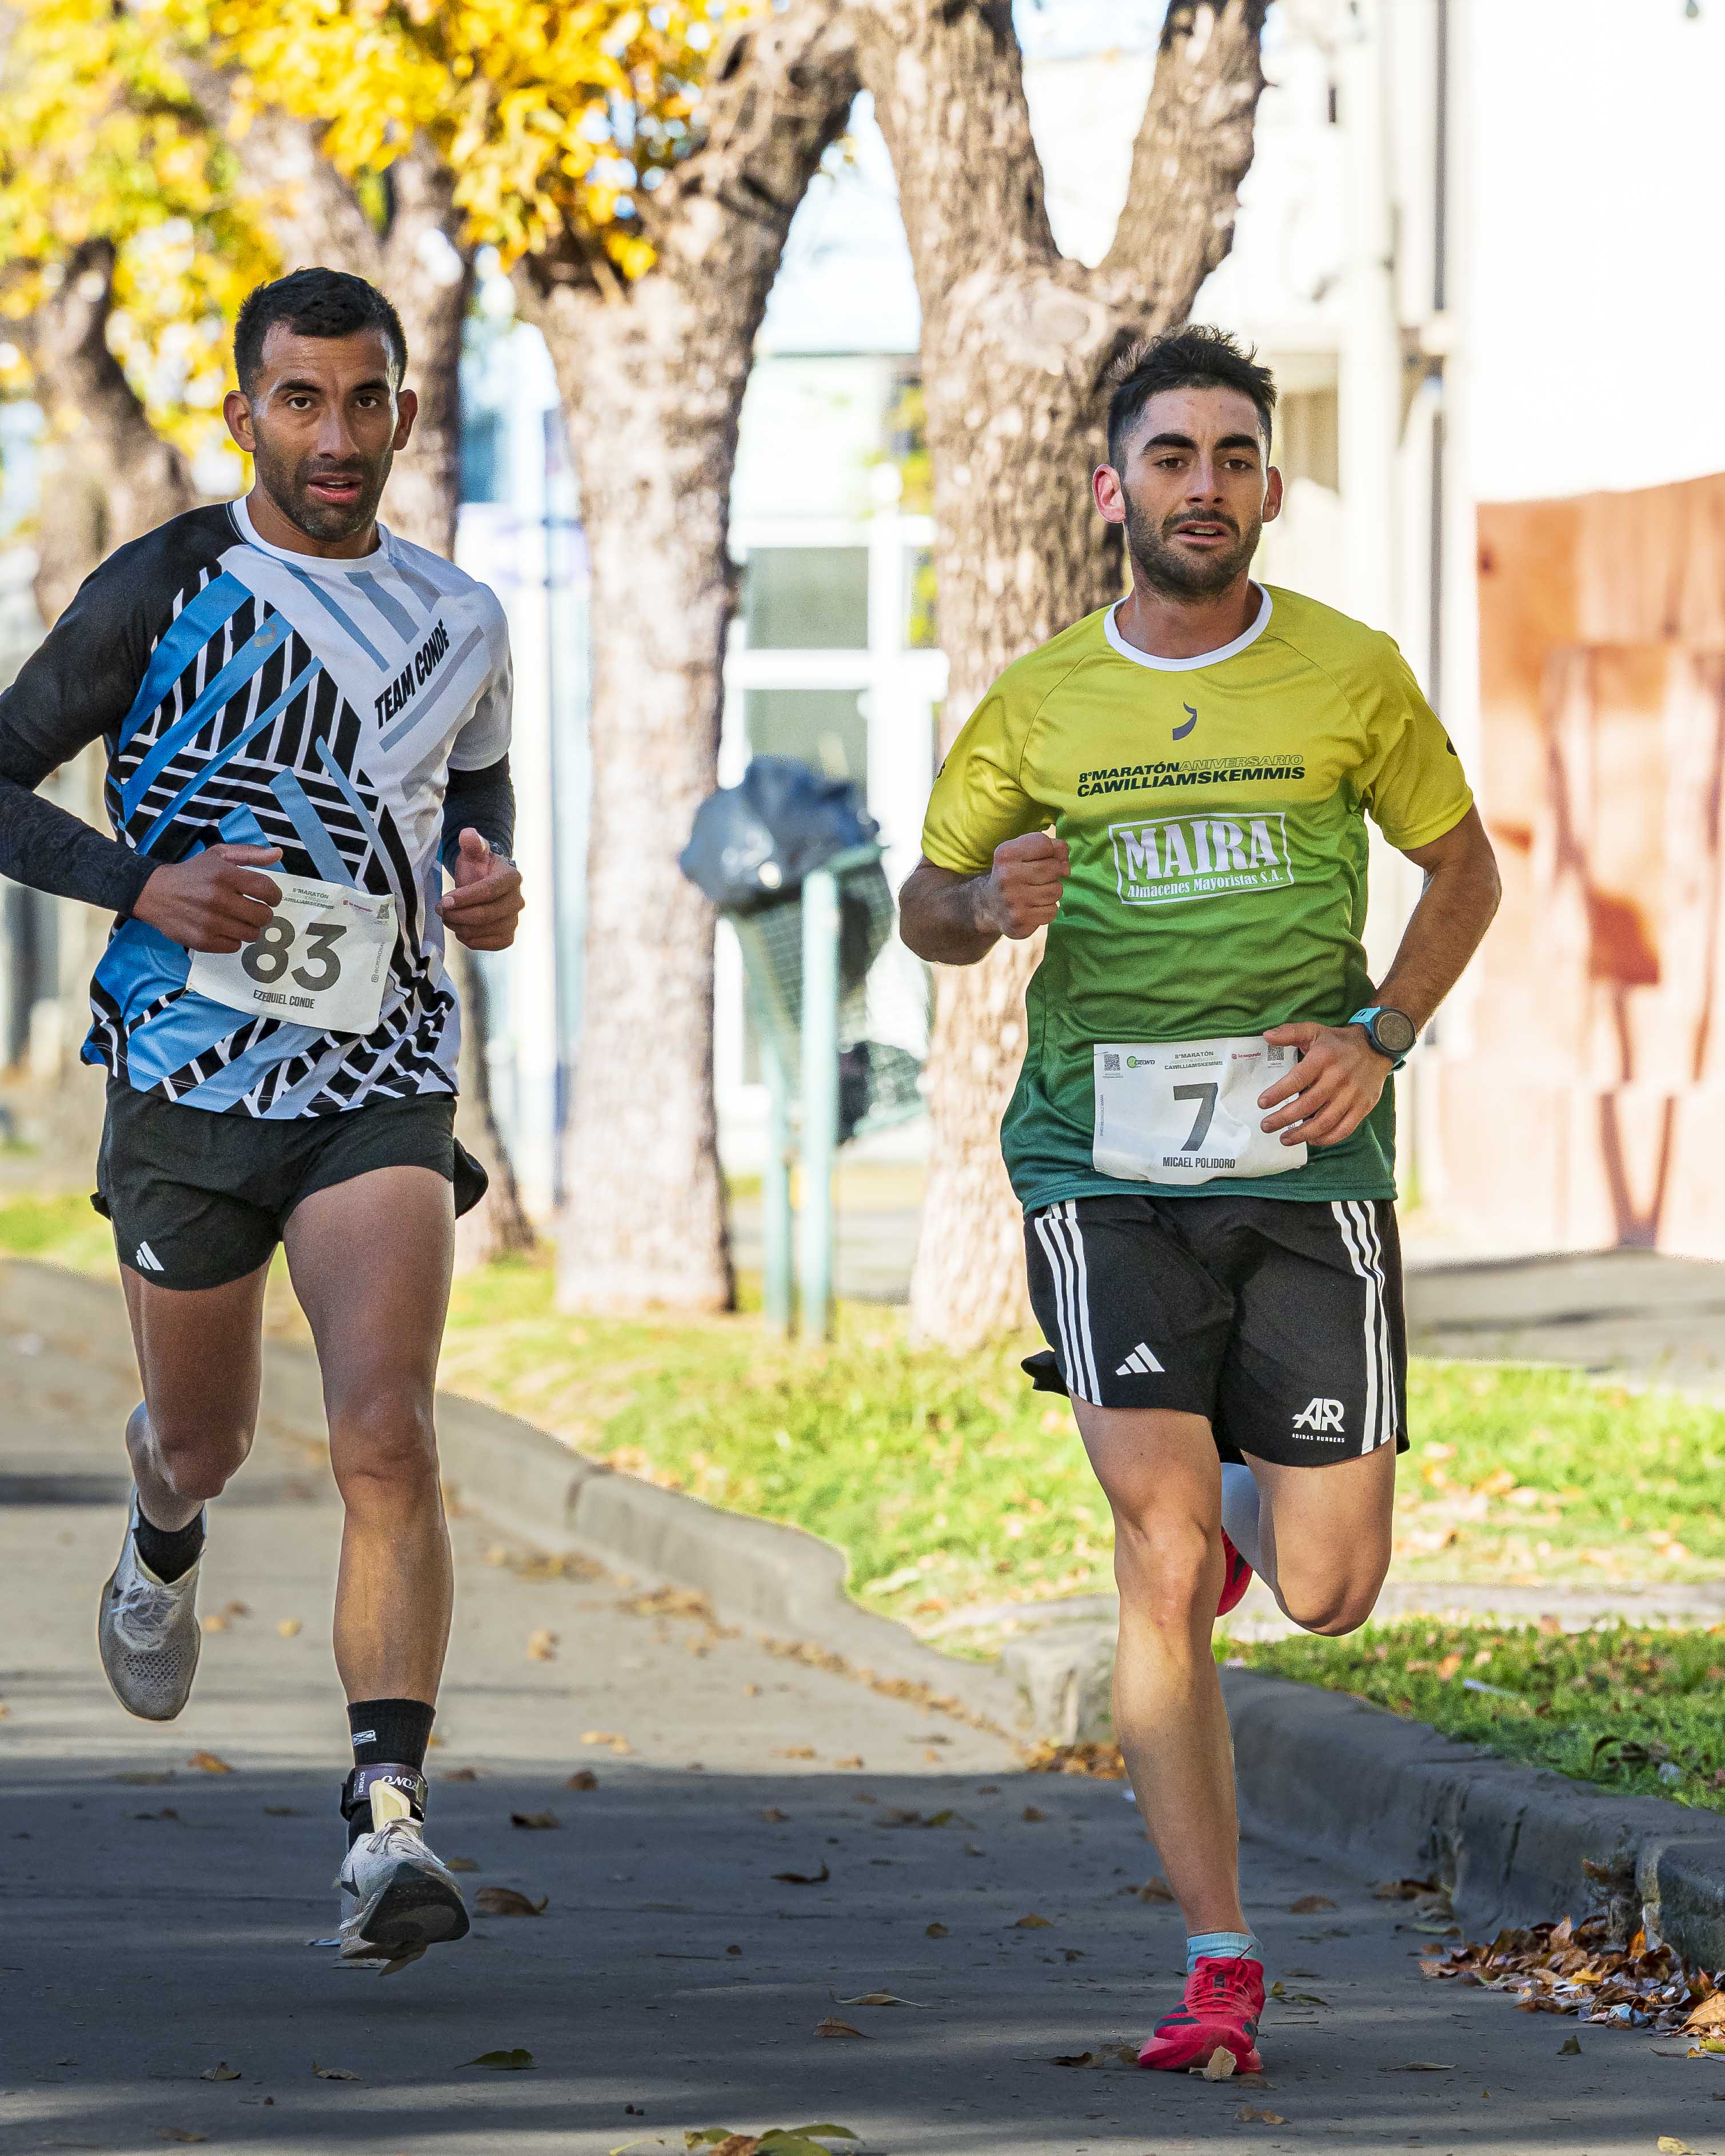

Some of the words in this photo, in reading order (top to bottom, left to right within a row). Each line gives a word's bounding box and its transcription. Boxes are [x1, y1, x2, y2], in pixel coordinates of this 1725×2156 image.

[374, 662, 416, 729] TEAM
[415, 618, 450, 686] CONDE
[1077, 766, 1305, 797] CAWILLIAMSKEMMIS
[1119, 820, 1280, 881] MAIRA
[1128, 880, 1190, 898] Almacenes
[1193, 873, 1257, 893] Mayoristas
[1260, 869, 1283, 884] S.A.
[241, 916, 347, 991] 83
[253, 989, 287, 1005] EZEQUIEL
[289, 996, 316, 1009] CONDE
[1173, 1083, 1218, 1151] 7
[1163, 1157, 1193, 1169] MICAEL
[1195, 1157, 1236, 1169] POLIDORO
[1292, 1398, 1345, 1432] AR
